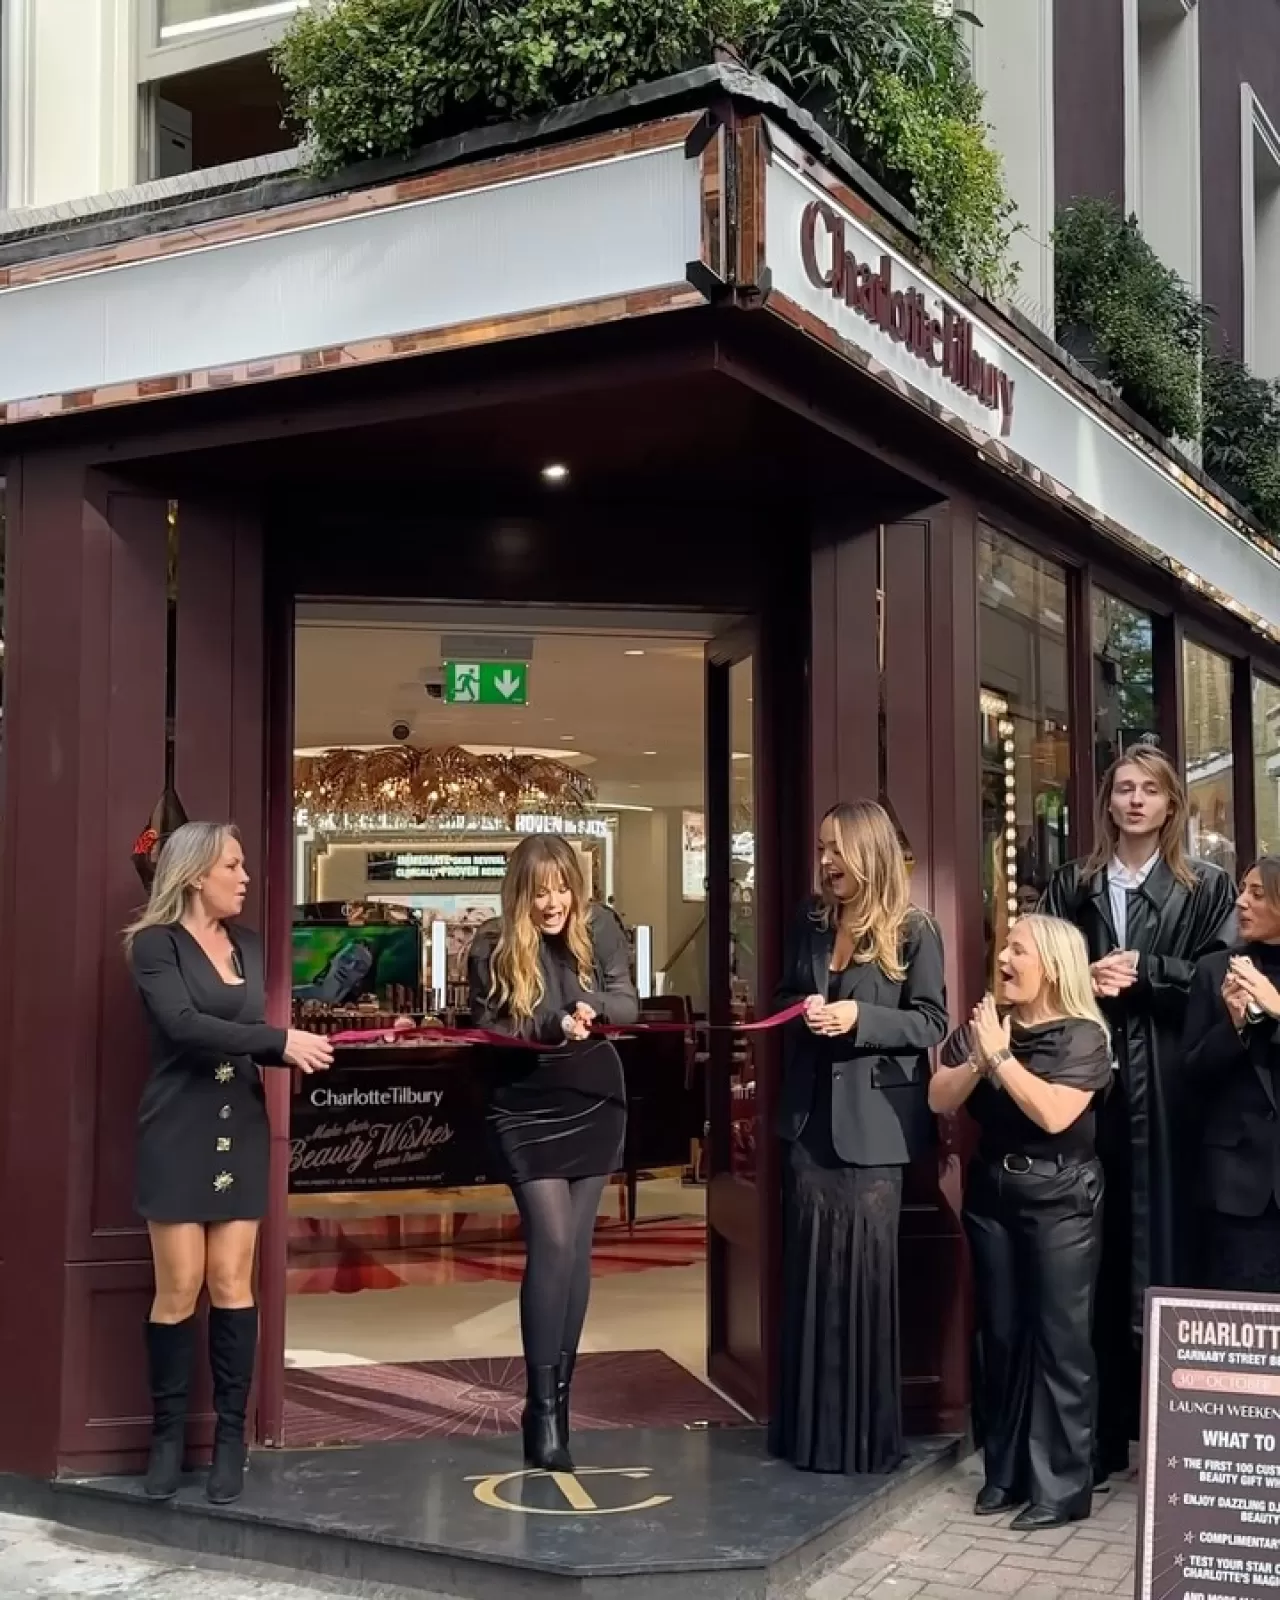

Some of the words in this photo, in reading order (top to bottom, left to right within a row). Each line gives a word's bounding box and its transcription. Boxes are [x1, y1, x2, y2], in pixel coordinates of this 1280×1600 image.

[369, 1115, 454, 1155] Wishes
[1178, 1320, 1280, 1349] CHARLOTT
[1177, 1349, 1226, 1362] CARNABY
[1228, 1353, 1267, 1365] STREET
[1169, 1400, 1224, 1415] LAUNCH
[1202, 1430, 1250, 1449] WHAT
[1254, 1434, 1276, 1451] TO
[1183, 1457, 1202, 1468] THE
[1205, 1459, 1233, 1471] FIRST
[1236, 1462, 1254, 1473] 100
[1199, 1471, 1237, 1483] BEAUTY
[1240, 1474, 1262, 1486] GIFT
[1183, 1493, 1215, 1506] ENJOY
[1217, 1497, 1266, 1511] DAZZLING
[1240, 1511, 1280, 1524] BEAUTY
[1189, 1555, 1215, 1566] TEST
[1216, 1558, 1244, 1570] YOUR
[1245, 1561, 1273, 1573] STAR
[1183, 1567, 1250, 1584] CHARLOTTE'S
